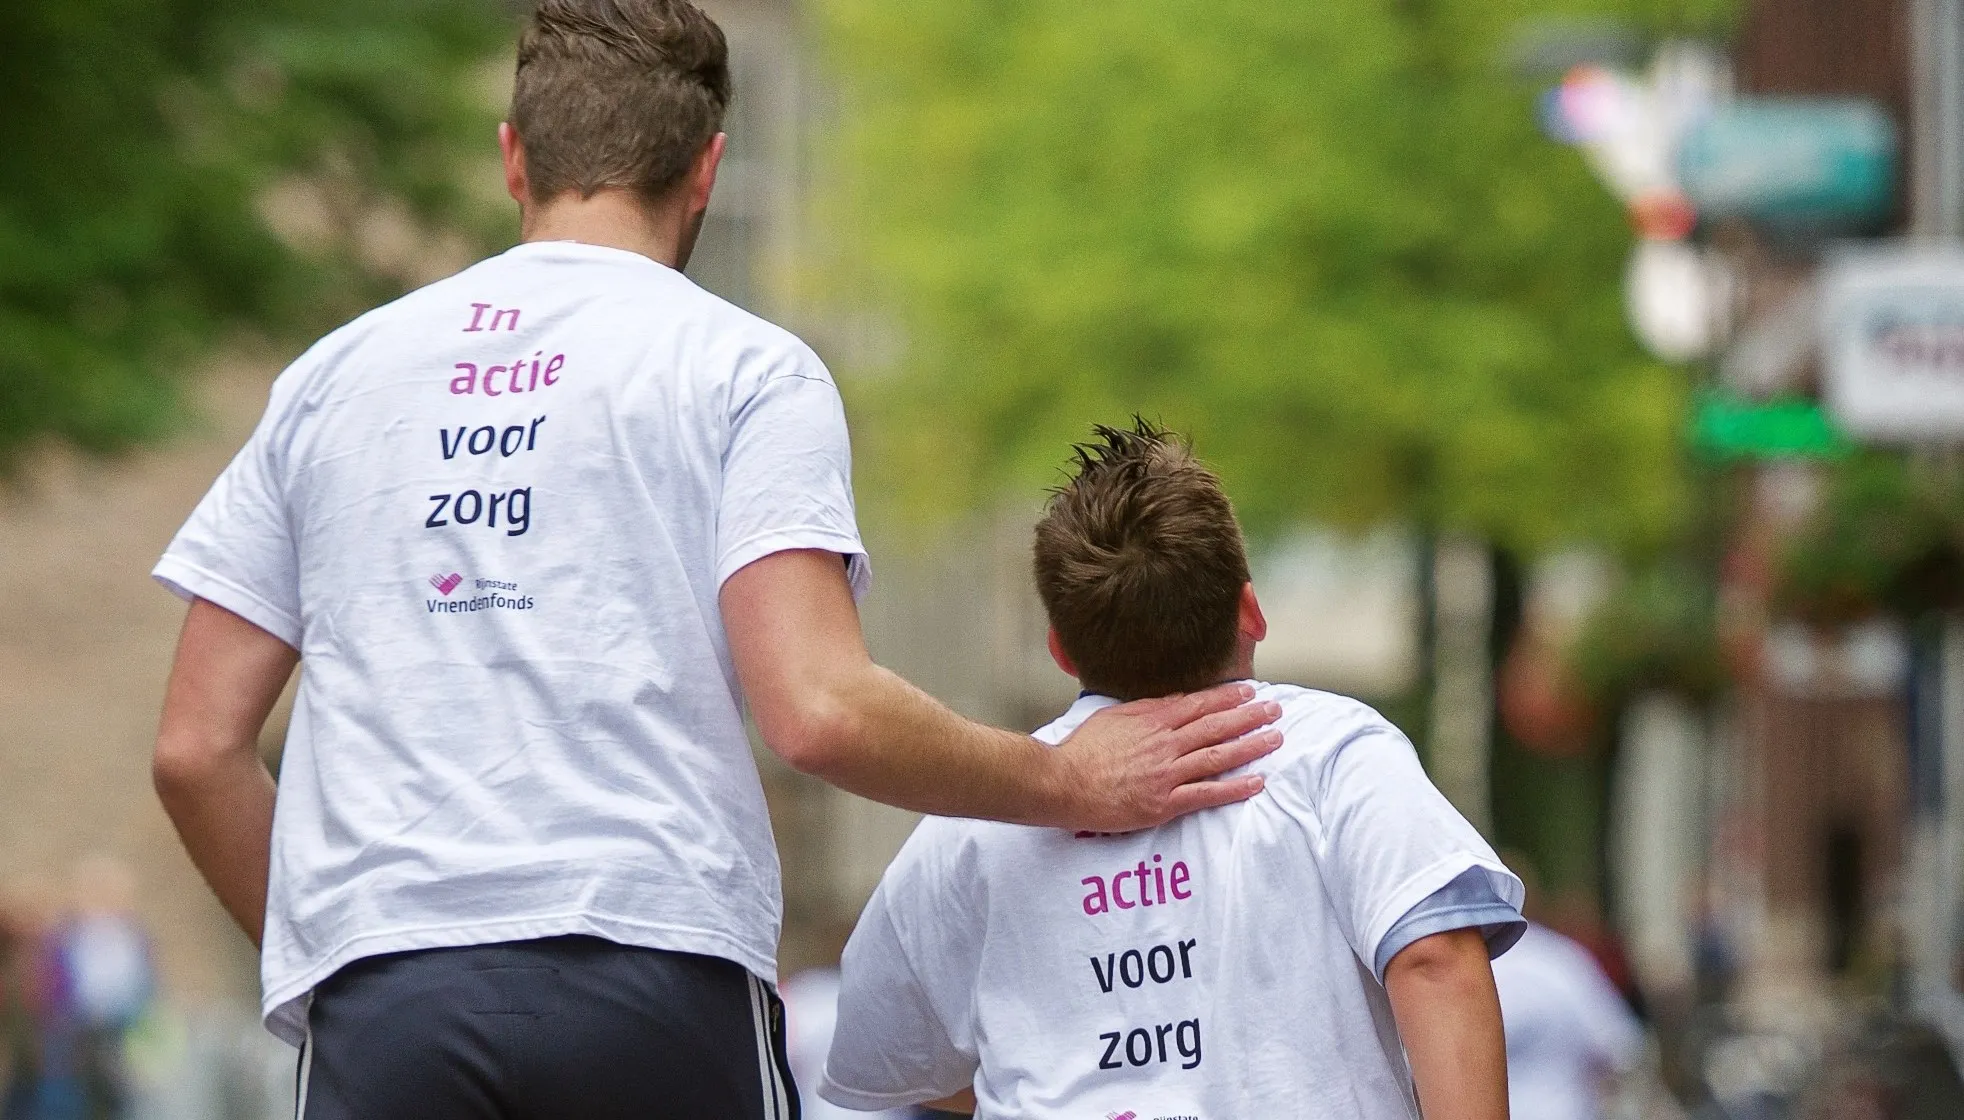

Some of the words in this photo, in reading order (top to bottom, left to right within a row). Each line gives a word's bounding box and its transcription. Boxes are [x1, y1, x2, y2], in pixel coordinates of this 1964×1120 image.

[462, 302, 521, 332] In
[449, 351, 565, 397] actie
[439, 415, 546, 460] voor
[425, 486, 532, 537] zorg
[1081, 854, 1192, 916] actie
[1090, 938, 1197, 994] voor
[1099, 1017, 1202, 1070] zorg
